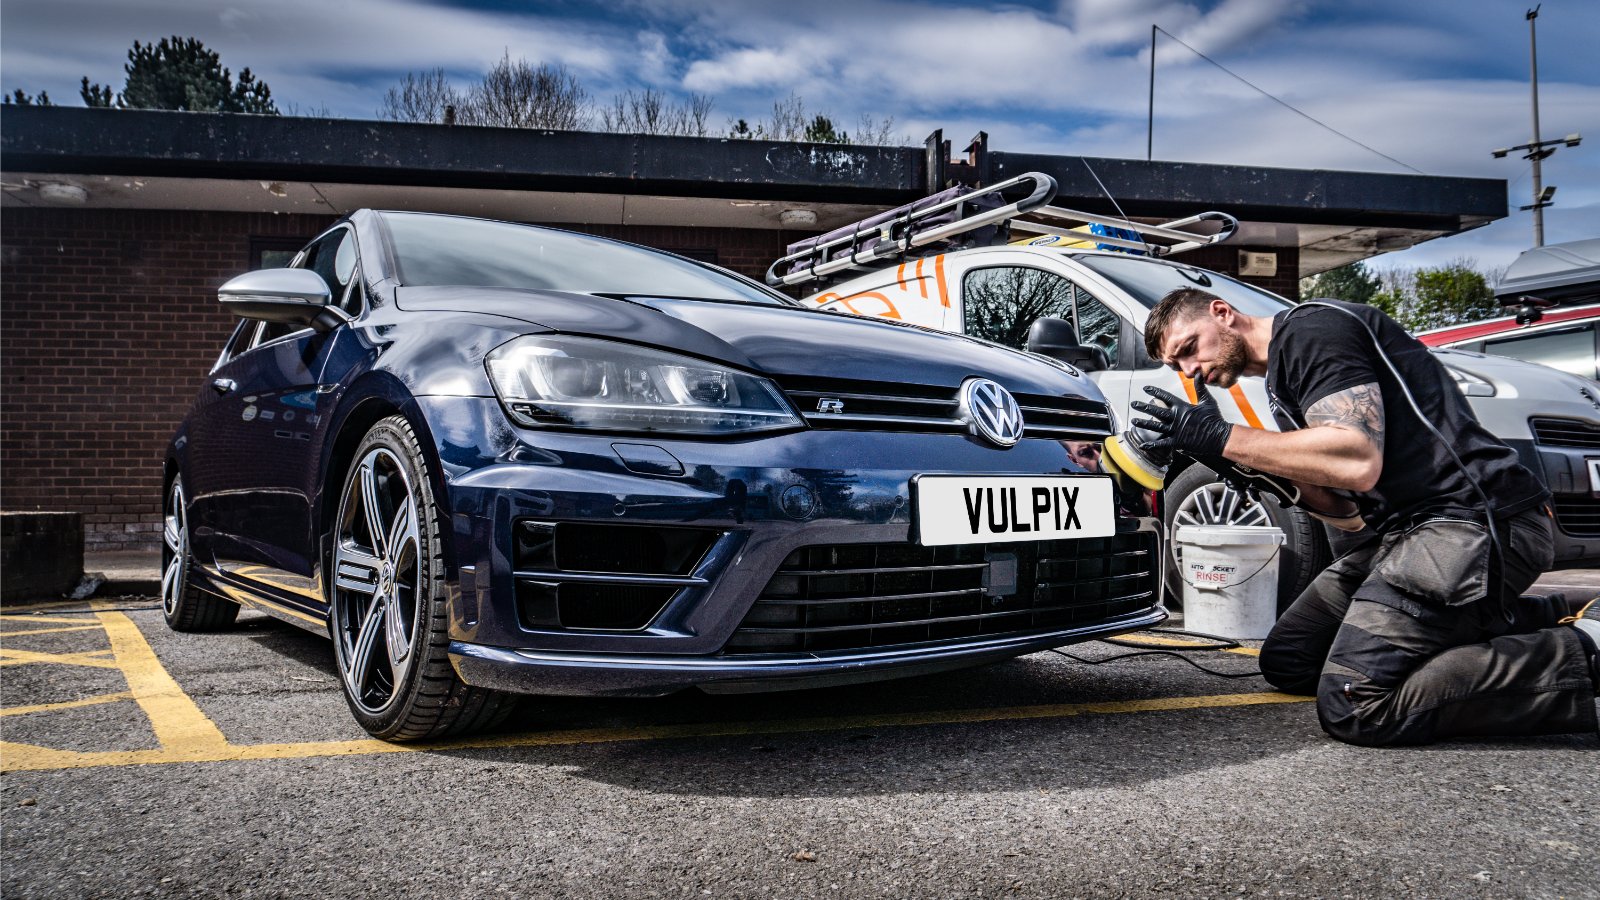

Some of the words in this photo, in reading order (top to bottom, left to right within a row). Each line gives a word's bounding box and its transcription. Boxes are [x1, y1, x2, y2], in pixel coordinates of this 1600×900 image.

[817, 398, 844, 413] R
[963, 487, 1081, 534] VULPIX
[1196, 571, 1226, 582] RINSE
